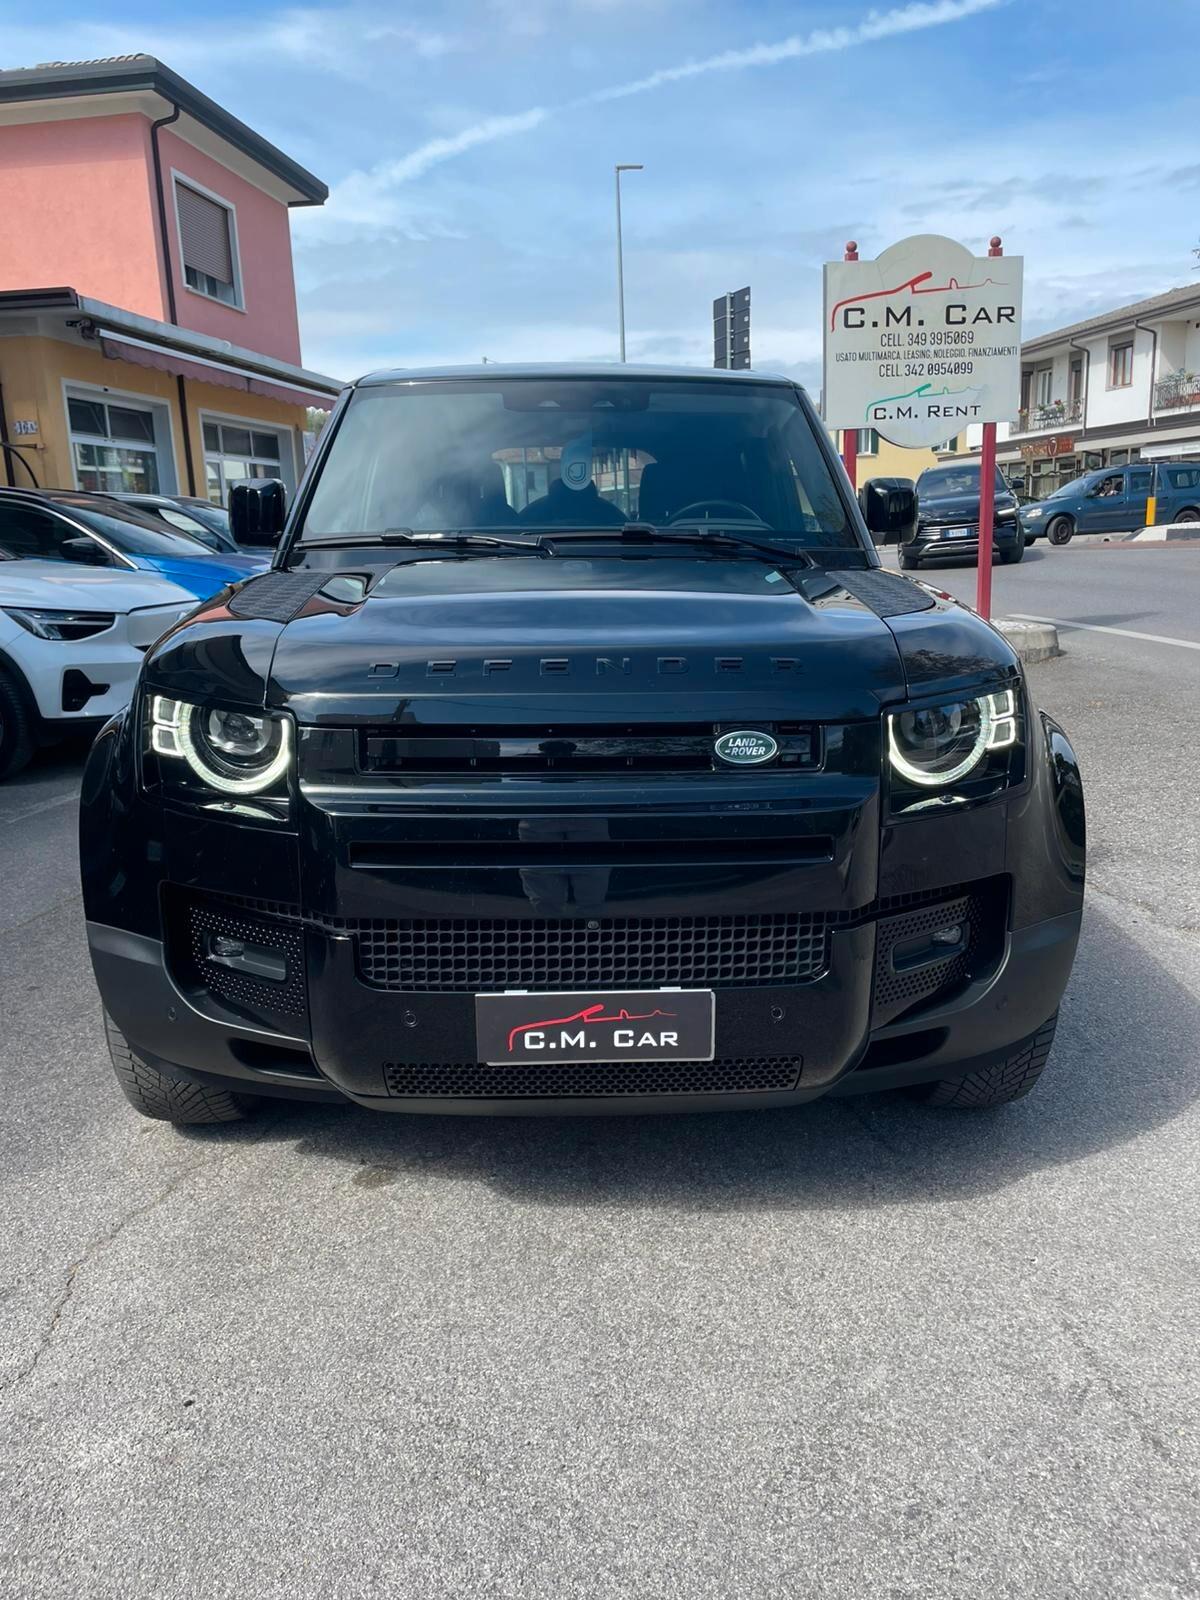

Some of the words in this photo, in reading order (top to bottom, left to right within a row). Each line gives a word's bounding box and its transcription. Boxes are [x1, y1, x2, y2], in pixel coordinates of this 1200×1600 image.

[843, 306, 924, 328] C.M.
[880, 333, 905, 347] CELL.
[907, 332, 928, 346] 349
[929, 331, 975, 345] 3915069
[835, 352, 857, 362] USATO
[968, 346, 1018, 358] FINANZIAMENTI
[879, 364, 902, 378] CELL.
[904, 363, 925, 377] 342
[927, 361, 974, 376] 0954099
[873, 406, 919, 420] C.M.
[367, 656, 802, 678] DEFENDER
[524, 1031, 597, 1049] C.M.
